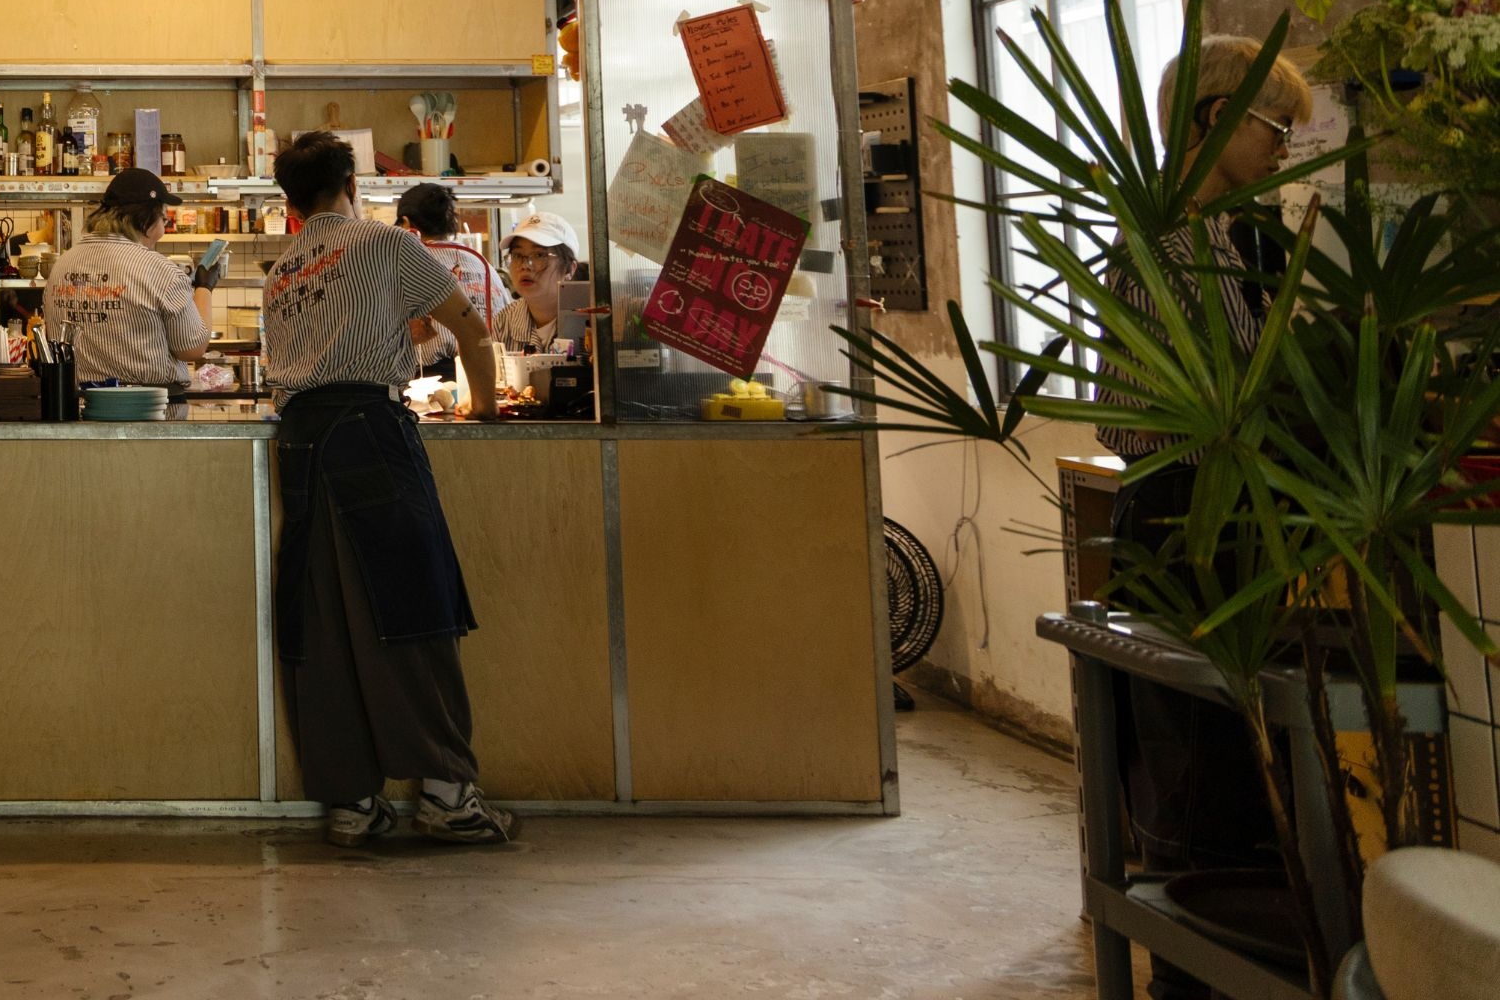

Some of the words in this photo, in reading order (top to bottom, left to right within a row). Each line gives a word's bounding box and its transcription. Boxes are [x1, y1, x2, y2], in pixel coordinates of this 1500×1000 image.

[64, 272, 91, 282] COME
[97, 273, 108, 282] TO
[77, 300, 98, 310] YOU
[102, 300, 124, 310] FEEL
